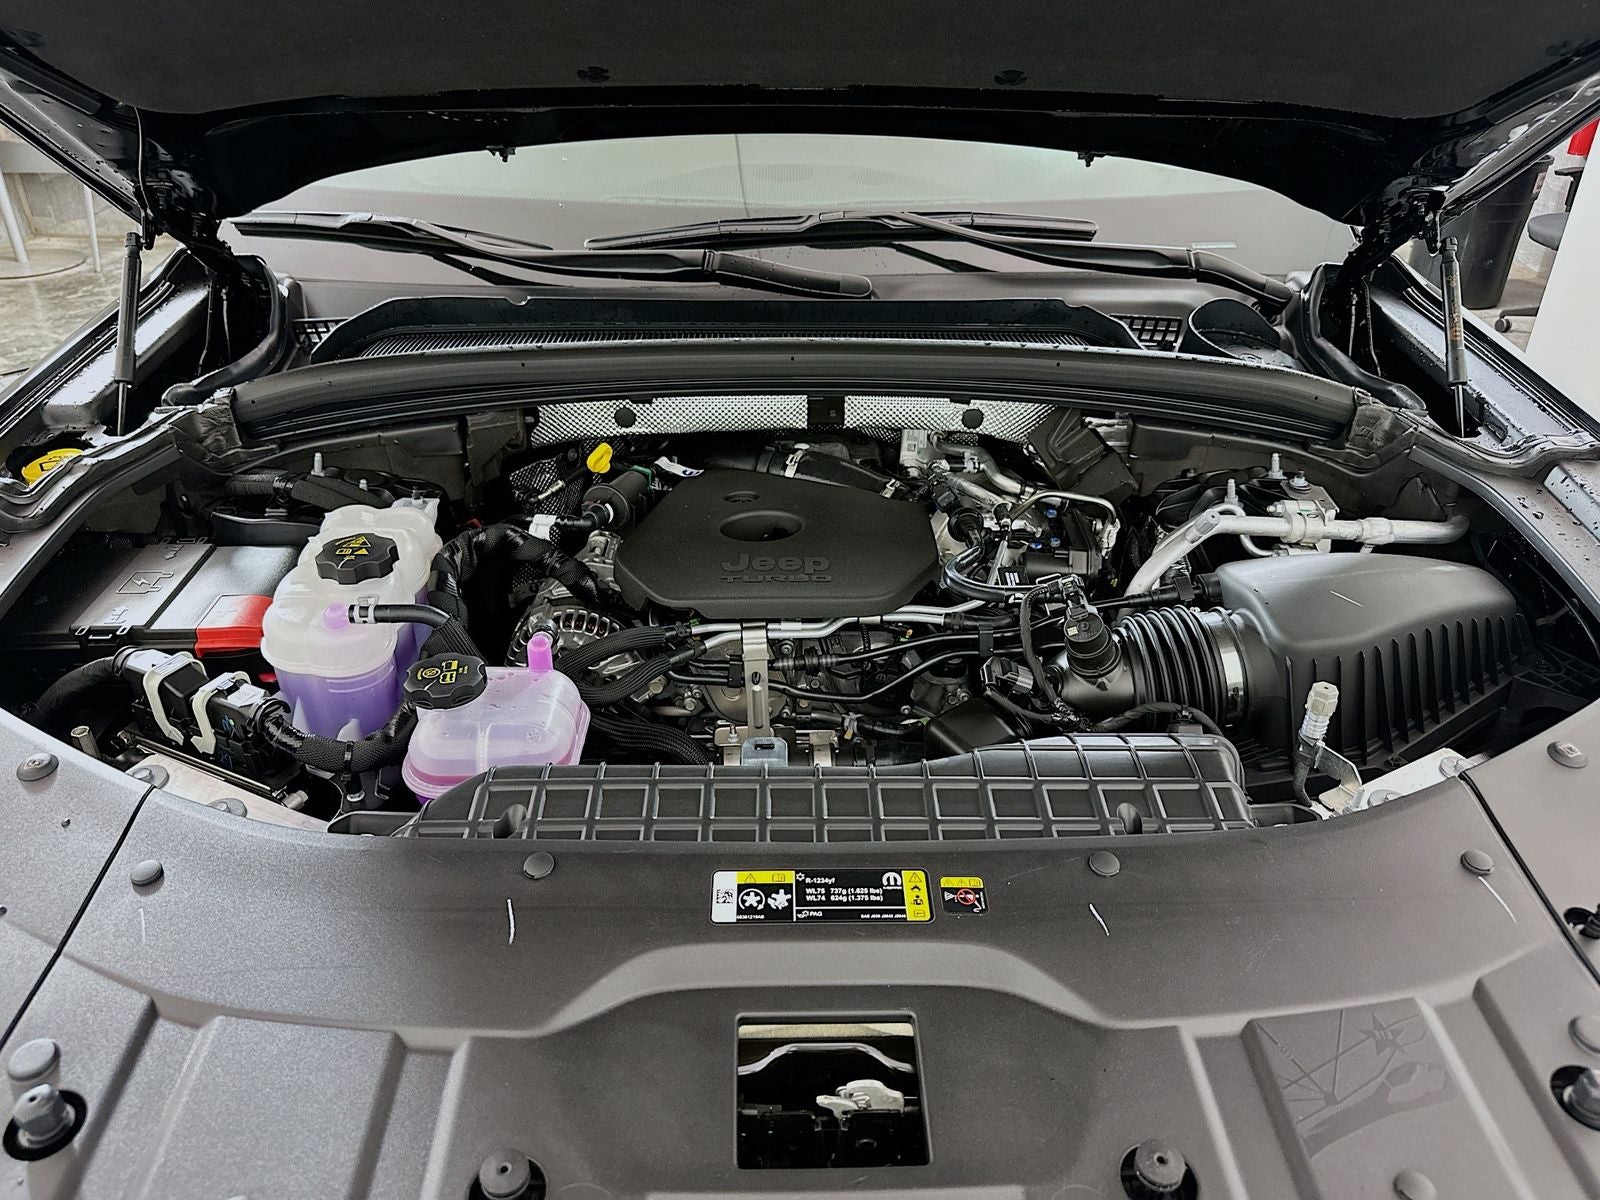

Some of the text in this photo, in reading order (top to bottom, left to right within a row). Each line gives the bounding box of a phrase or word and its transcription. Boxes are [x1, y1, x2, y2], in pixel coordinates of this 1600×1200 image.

[721, 553, 830, 574] Jeep
[720, 574, 832, 583] TURBO
[805, 877, 836, 885] R-1234yf
[830, 887, 847, 895] 737g
[848, 887, 869, 895] (1.625
[869, 887, 883, 895] lbs)
